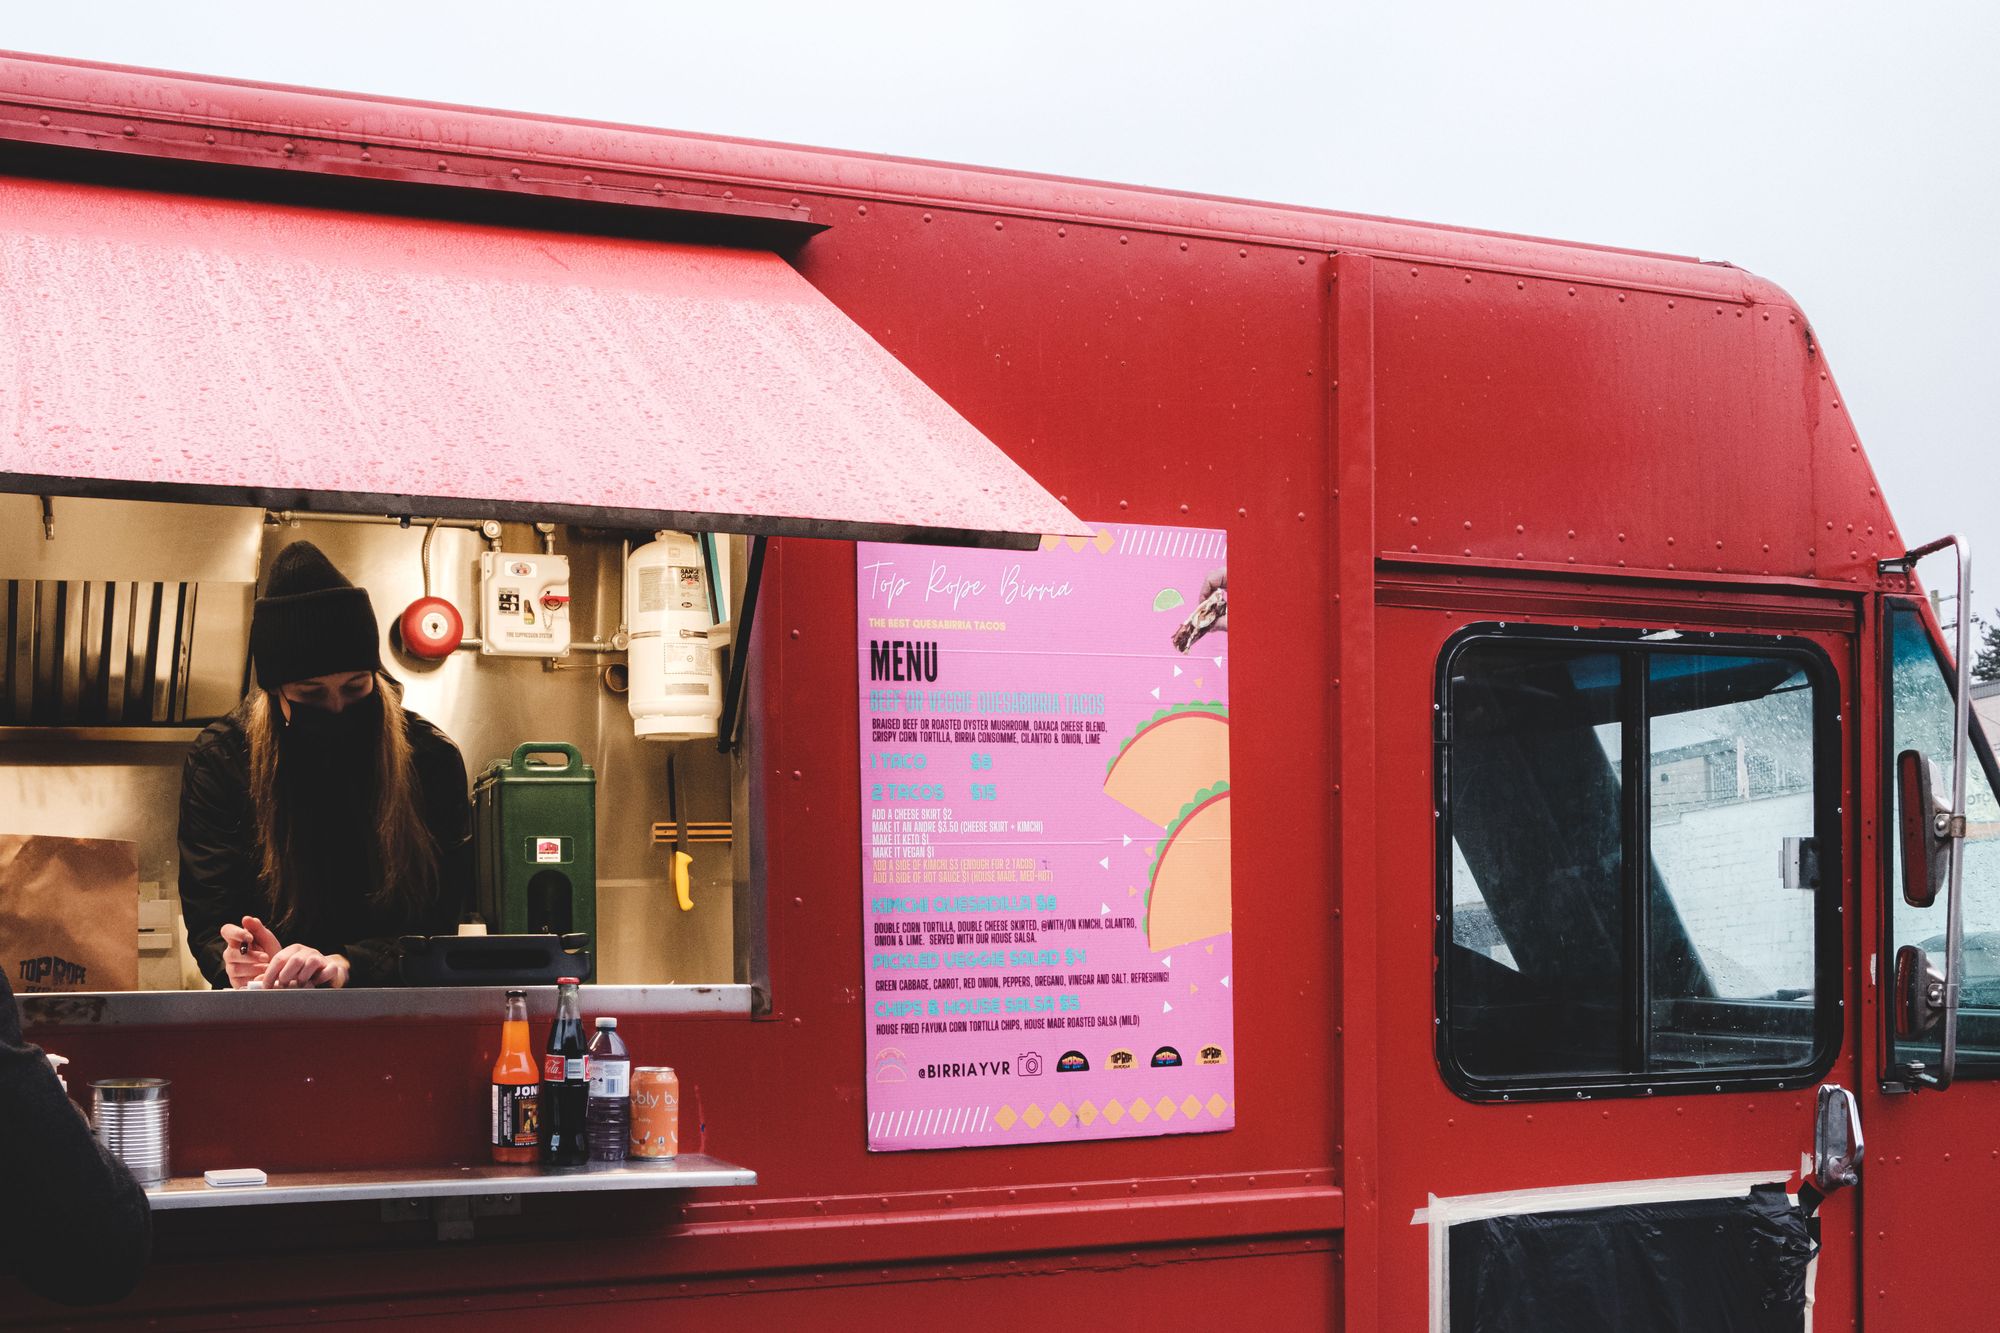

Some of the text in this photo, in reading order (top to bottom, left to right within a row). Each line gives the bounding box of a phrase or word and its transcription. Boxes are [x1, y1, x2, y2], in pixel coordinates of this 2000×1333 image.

[864, 560, 1073, 610] Top Rope Birria
[869, 618, 1006, 631] THE BEST QUESABIRRIA TACOS
[870, 640, 937, 682] MENU
[870, 690, 1105, 715] BEEF OR VEGGIE QUESABIRRIA TACOS
[872, 718, 1107, 733] BRAISED BEEF OR ROASTED OYSTER MUSHROOM, OAXACA CHEESE BLEND,
[872, 731, 1100, 745] CRISPY CORN TORTILLA, BIRRIA CONSOMME, CILANTRO & ONION, LIME
[870, 753, 877, 769] 1
[880, 753, 927, 769] TACO
[871, 782, 997, 801] 2 TACOS $15
[872, 807, 953, 821] ADD A CHEESE SKIRT $2
[872, 821, 892, 833] MAKE
[894, 821, 900, 833] IT
[902, 821, 912, 833] AN
[914, 821, 936, 833] ANDRE
[938, 821, 959, 834] $3.50
[961, 821, 987, 834] (CHEESE
[989, 821, 1009, 833] SKIRT
[1017, 821, 1043, 834] KIMCHI)
[872, 833, 929, 846] MAKE IT KETO $1
[873, 846, 935, 859] MAKE IT VEGAN $1
[873, 859, 887, 870] ADD
[889, 859, 894, 870] A
[896, 859, 911, 870] SIDE
[913, 859, 921, 870] OF
[923, 859, 948, 870] KIMCHI
[961, 858, 990, 871] (ENOUGH
[992, 859, 1005, 870] FOR
[1006, 859, 1010, 870] 2
[1012, 858, 1036, 871] TACOS)
[873, 871, 887, 883] ADD
[889, 871, 894, 883] A
[896, 871, 911, 883] SIDE
[913, 871, 921, 883] OF
[924, 871, 936, 883] HOT
[939, 871, 960, 883] SAUCE
[972, 871, 995, 884] (HOUSE
[871, 897, 928, 913] KIMCHI
[933, 895, 1031, 912] QUESADILLA
[874, 922, 900, 934] DOUBLE
[902, 921, 920, 933] CORN
[923, 921, 956, 933] TORTILLA,
[958, 920, 982, 932] DOUBLE
[984, 920, 1008, 931] CHEESE
[1010, 919, 1039, 931] SKIRTED,
[1078, 918, 1103, 930] KIMCHI,
[1105, 918, 1137, 929] CILANTRO,
[875, 932, 1037, 946] ONION & LIME. SERVED WITH OUR HOUSE SALSA.
[872, 947, 1086, 970] PICKLED VEGGIE SALAD $4
[20, 956, 52, 983] TOP
[875, 972, 1169, 991] GREEN CABBAGE, CARROT, RED ONION, PEPPERS, OREGANO, VINEGAR AND SALT. REFRESHING!
[874, 994, 1080, 1017] CHIPS & HOUSE SALSA $5
[876, 1014, 1140, 1035] HOUSE FRIED FAYUKA CORN TORTILLA CHIPS, HOUSE MADE ROASTED SALSA (MILD)
[918, 1061, 1010, 1079] @BIRRIAYVR
